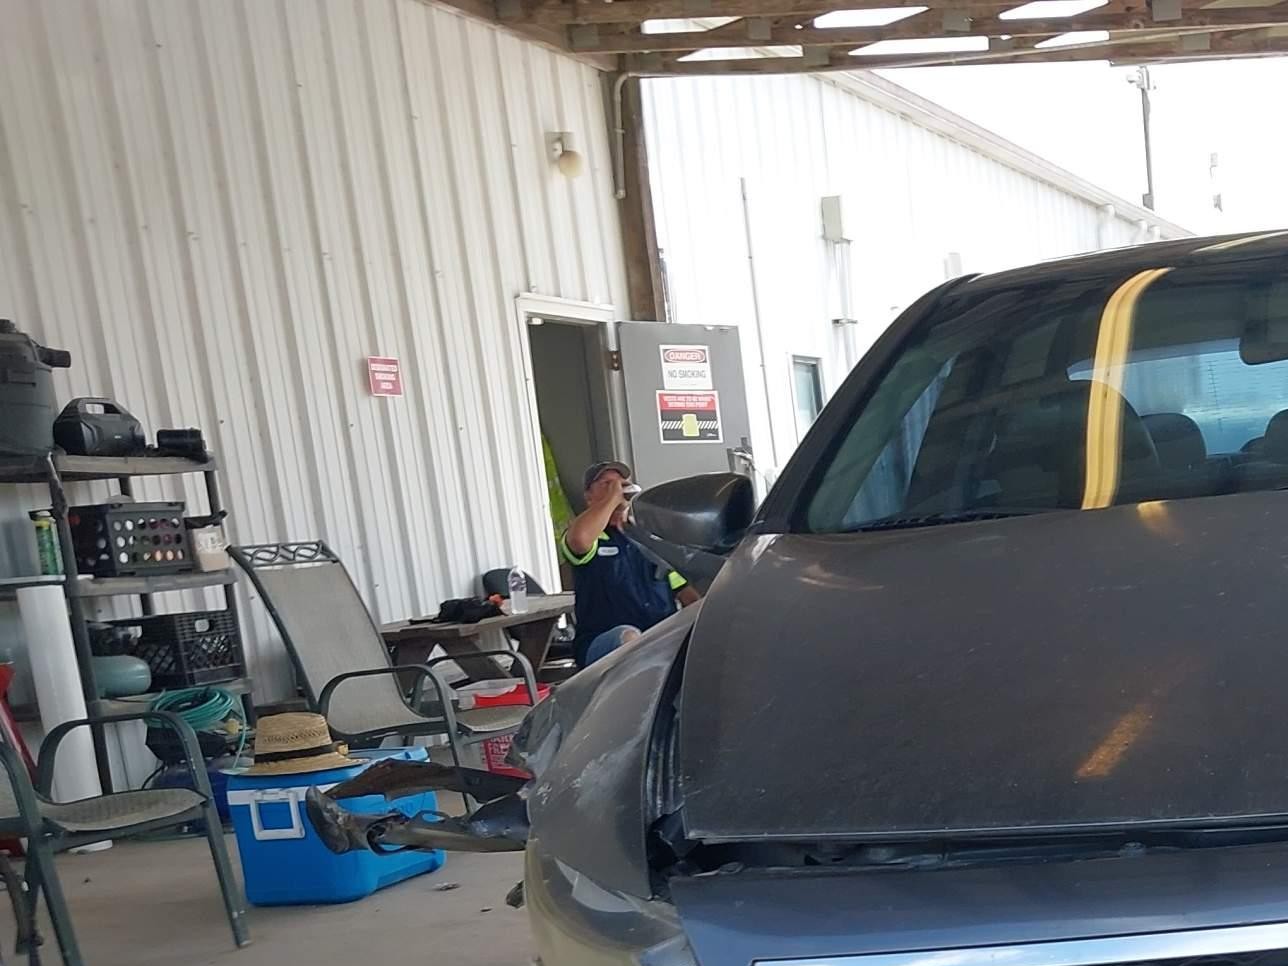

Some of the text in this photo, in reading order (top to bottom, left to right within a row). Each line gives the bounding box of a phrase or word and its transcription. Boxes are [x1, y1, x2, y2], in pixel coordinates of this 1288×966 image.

[669, 351, 703, 361] DANGER
[667, 369, 706, 378] NO SMOKING
